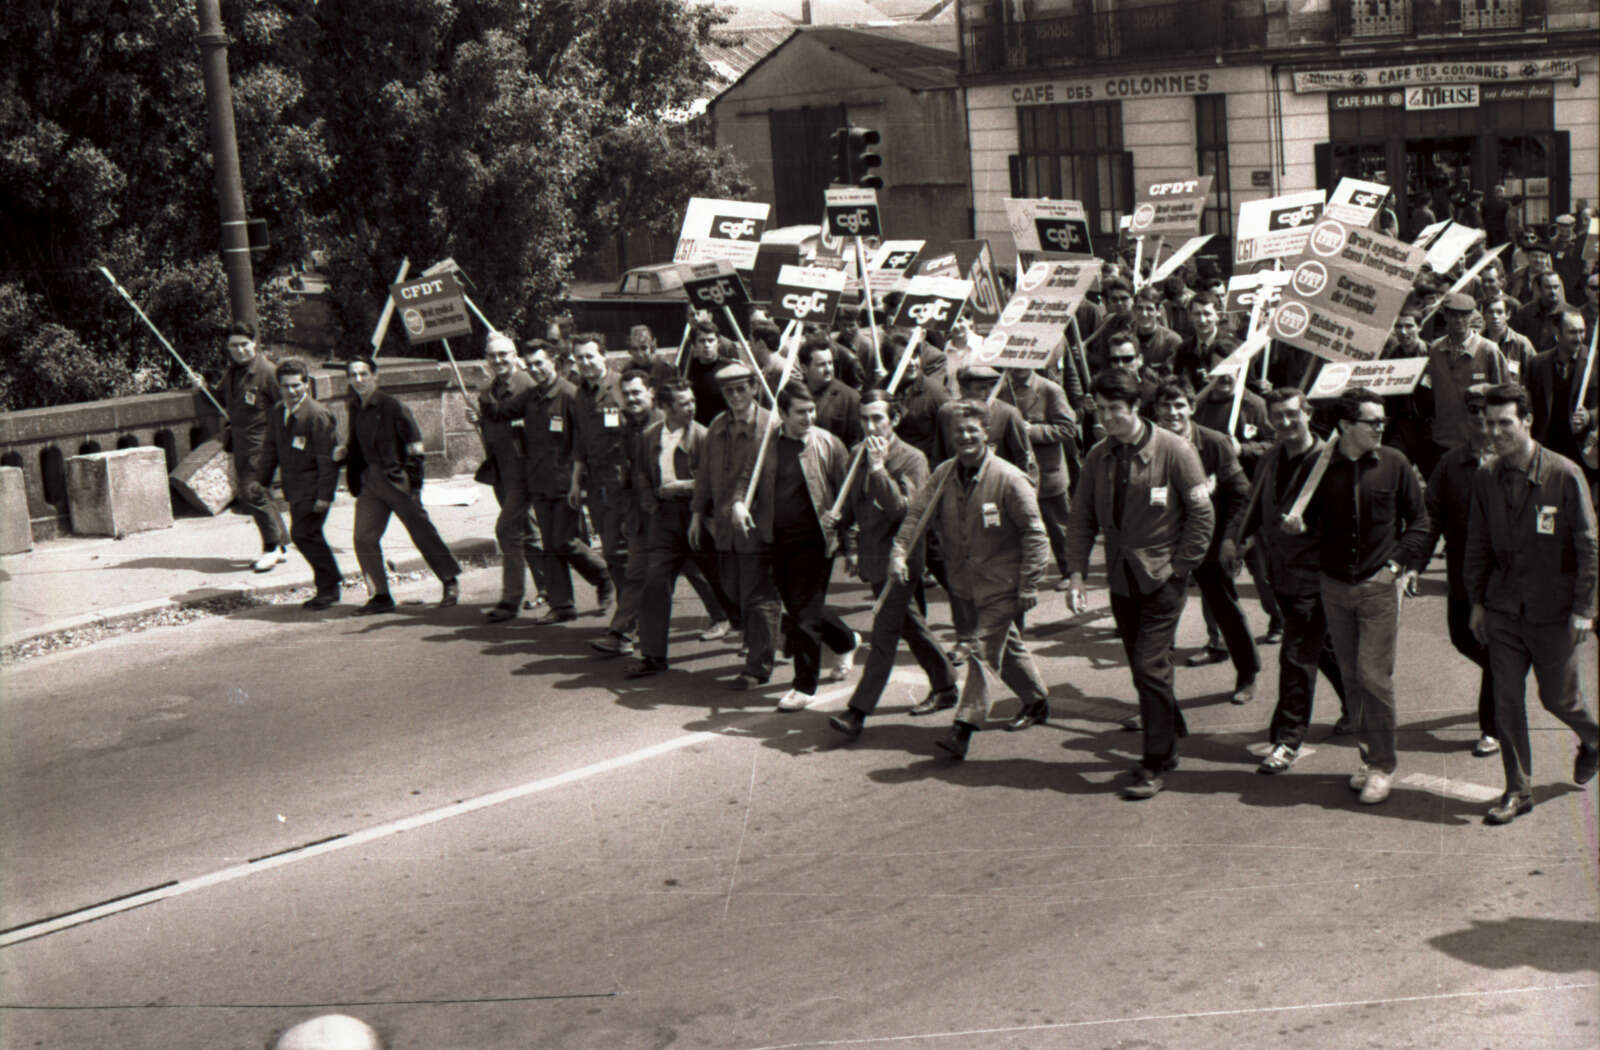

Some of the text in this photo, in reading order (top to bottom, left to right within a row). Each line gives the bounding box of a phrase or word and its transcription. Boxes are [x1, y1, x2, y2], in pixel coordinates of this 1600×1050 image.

[1416, 65, 1437, 79] DES
[1442, 64, 1508, 79] COLONNES
[1066, 85, 1093, 100] DES
[1105, 74, 1210, 96] COLONNES
[1422, 87, 1477, 107] MEUSE
[1148, 181, 1198, 196] CFDT
[836, 208, 871, 233] cgt
[1278, 206, 1315, 228] cgt
[719, 219, 756, 239] cgt
[1046, 223, 1080, 250] cgt
[401, 280, 443, 299] CFDT
[697, 280, 735, 304] cgt
[782, 291, 828, 318] cgt
[907, 299, 952, 325] cgt
